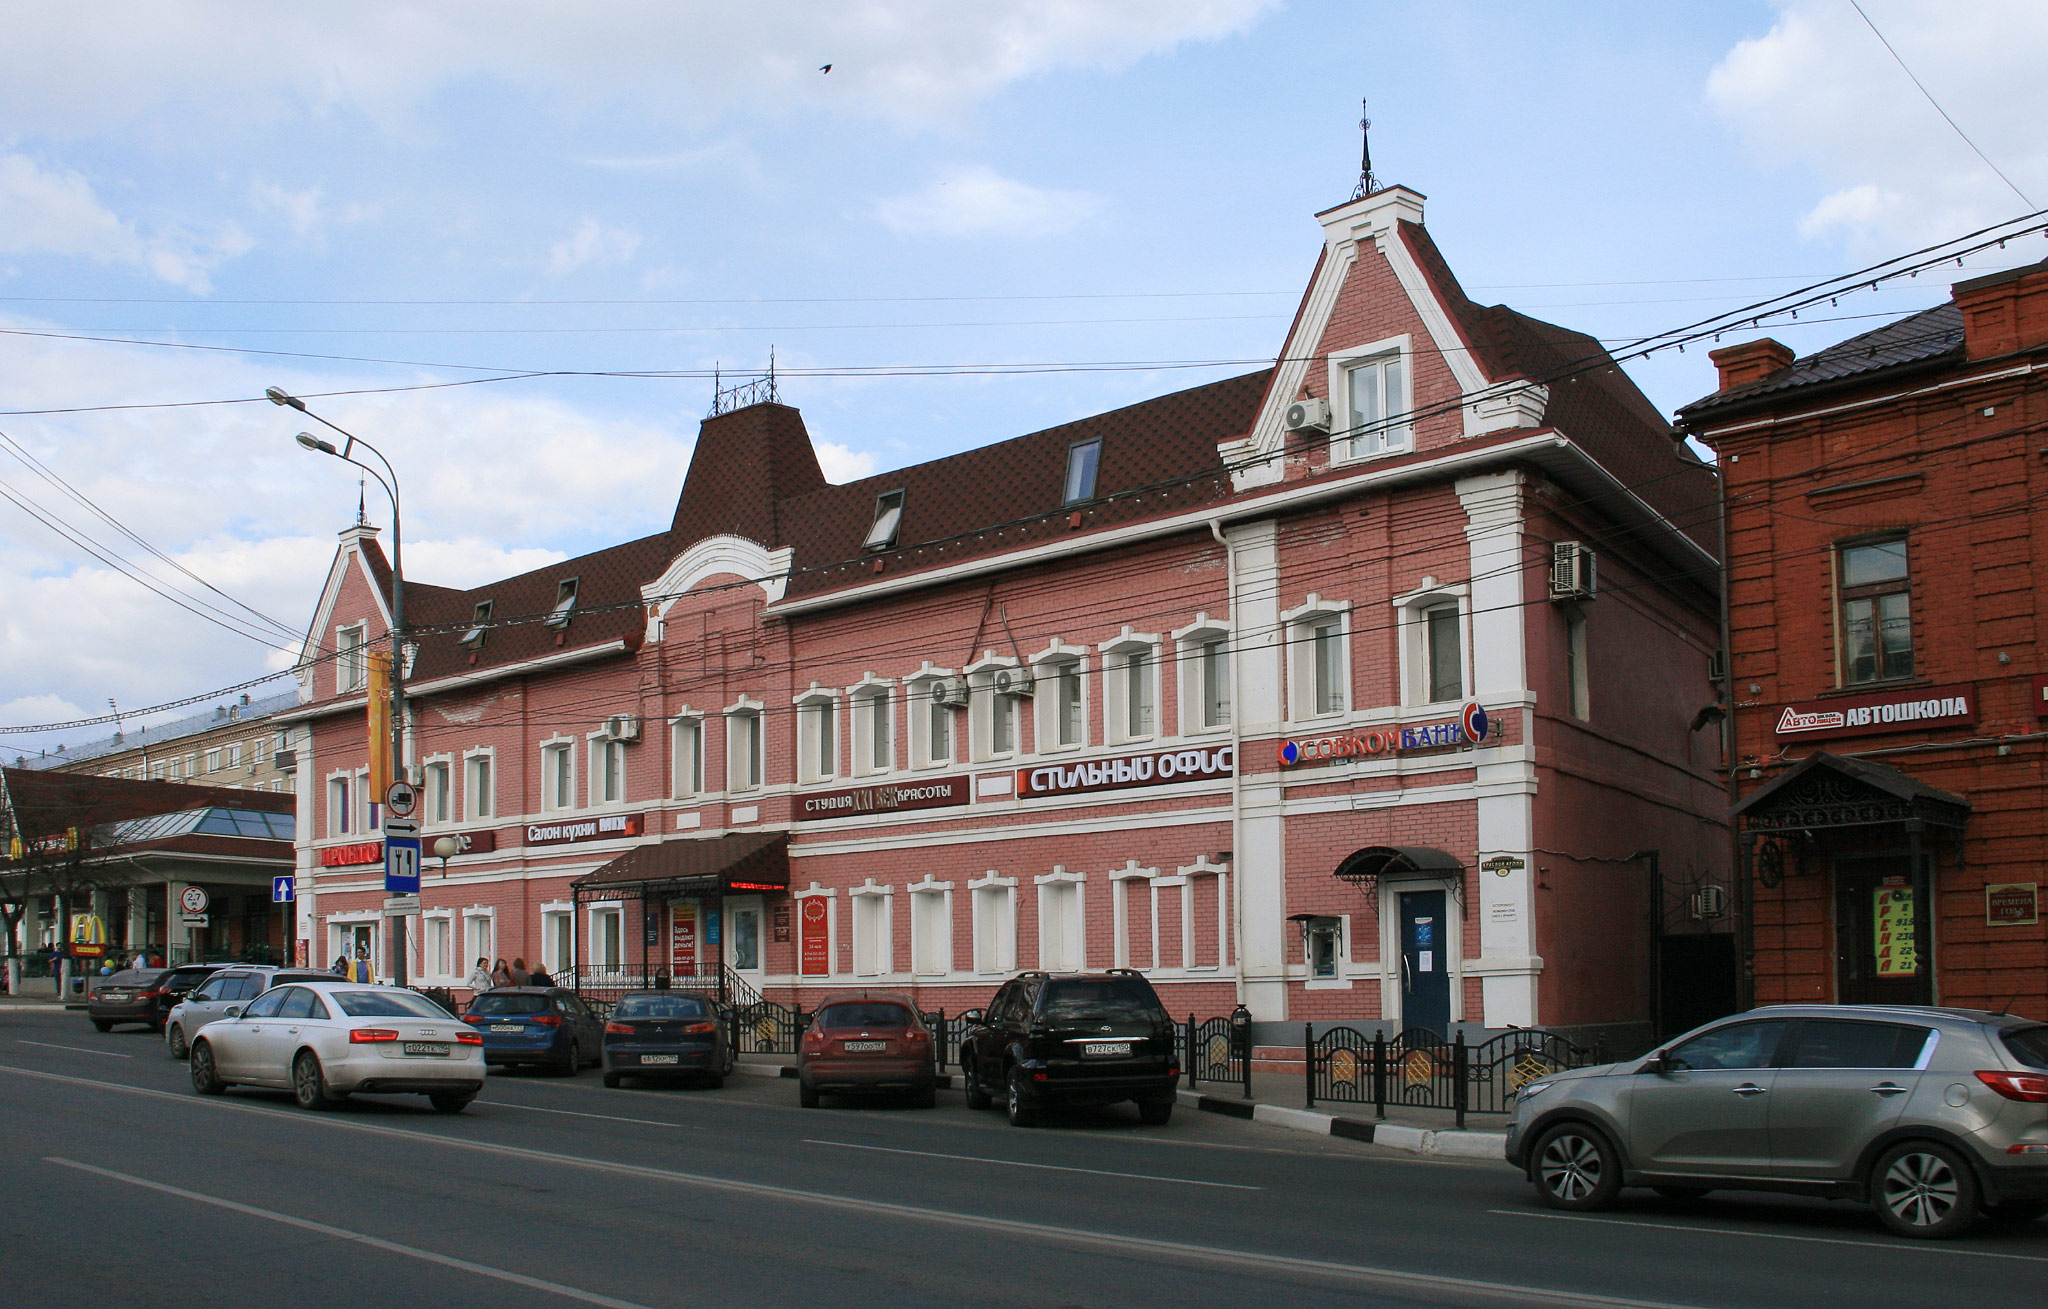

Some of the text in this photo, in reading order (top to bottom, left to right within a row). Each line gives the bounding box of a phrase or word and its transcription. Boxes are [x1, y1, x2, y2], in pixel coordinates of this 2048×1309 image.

[1846, 697, 1968, 727] АВТОШКОЛА
[1031, 747, 1233, 792] СТИЛЬНЫЙ ОФИС
[805, 795, 852, 812] СТУДИЯ
[897, 785, 952, 802] КРАСОТЫ
[528, 823, 596, 842] Салон кухни
